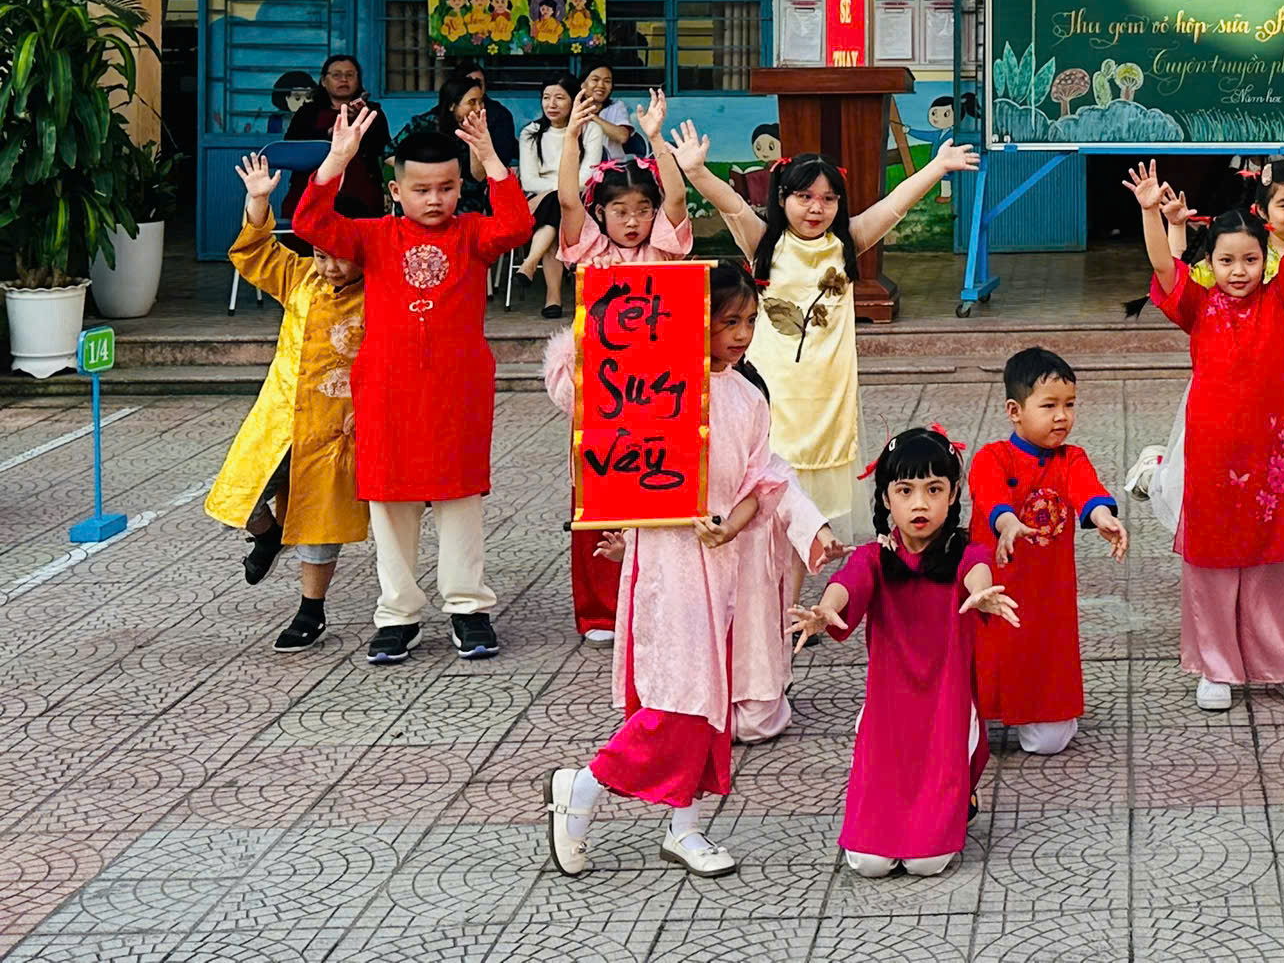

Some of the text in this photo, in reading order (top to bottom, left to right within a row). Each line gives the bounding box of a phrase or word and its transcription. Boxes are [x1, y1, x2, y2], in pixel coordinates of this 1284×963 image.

[1052, 7, 1101, 42] Thu
[832, 51, 858, 67] THAY
[88, 337, 109, 364] 1/4
[597, 358, 686, 420] Sum
